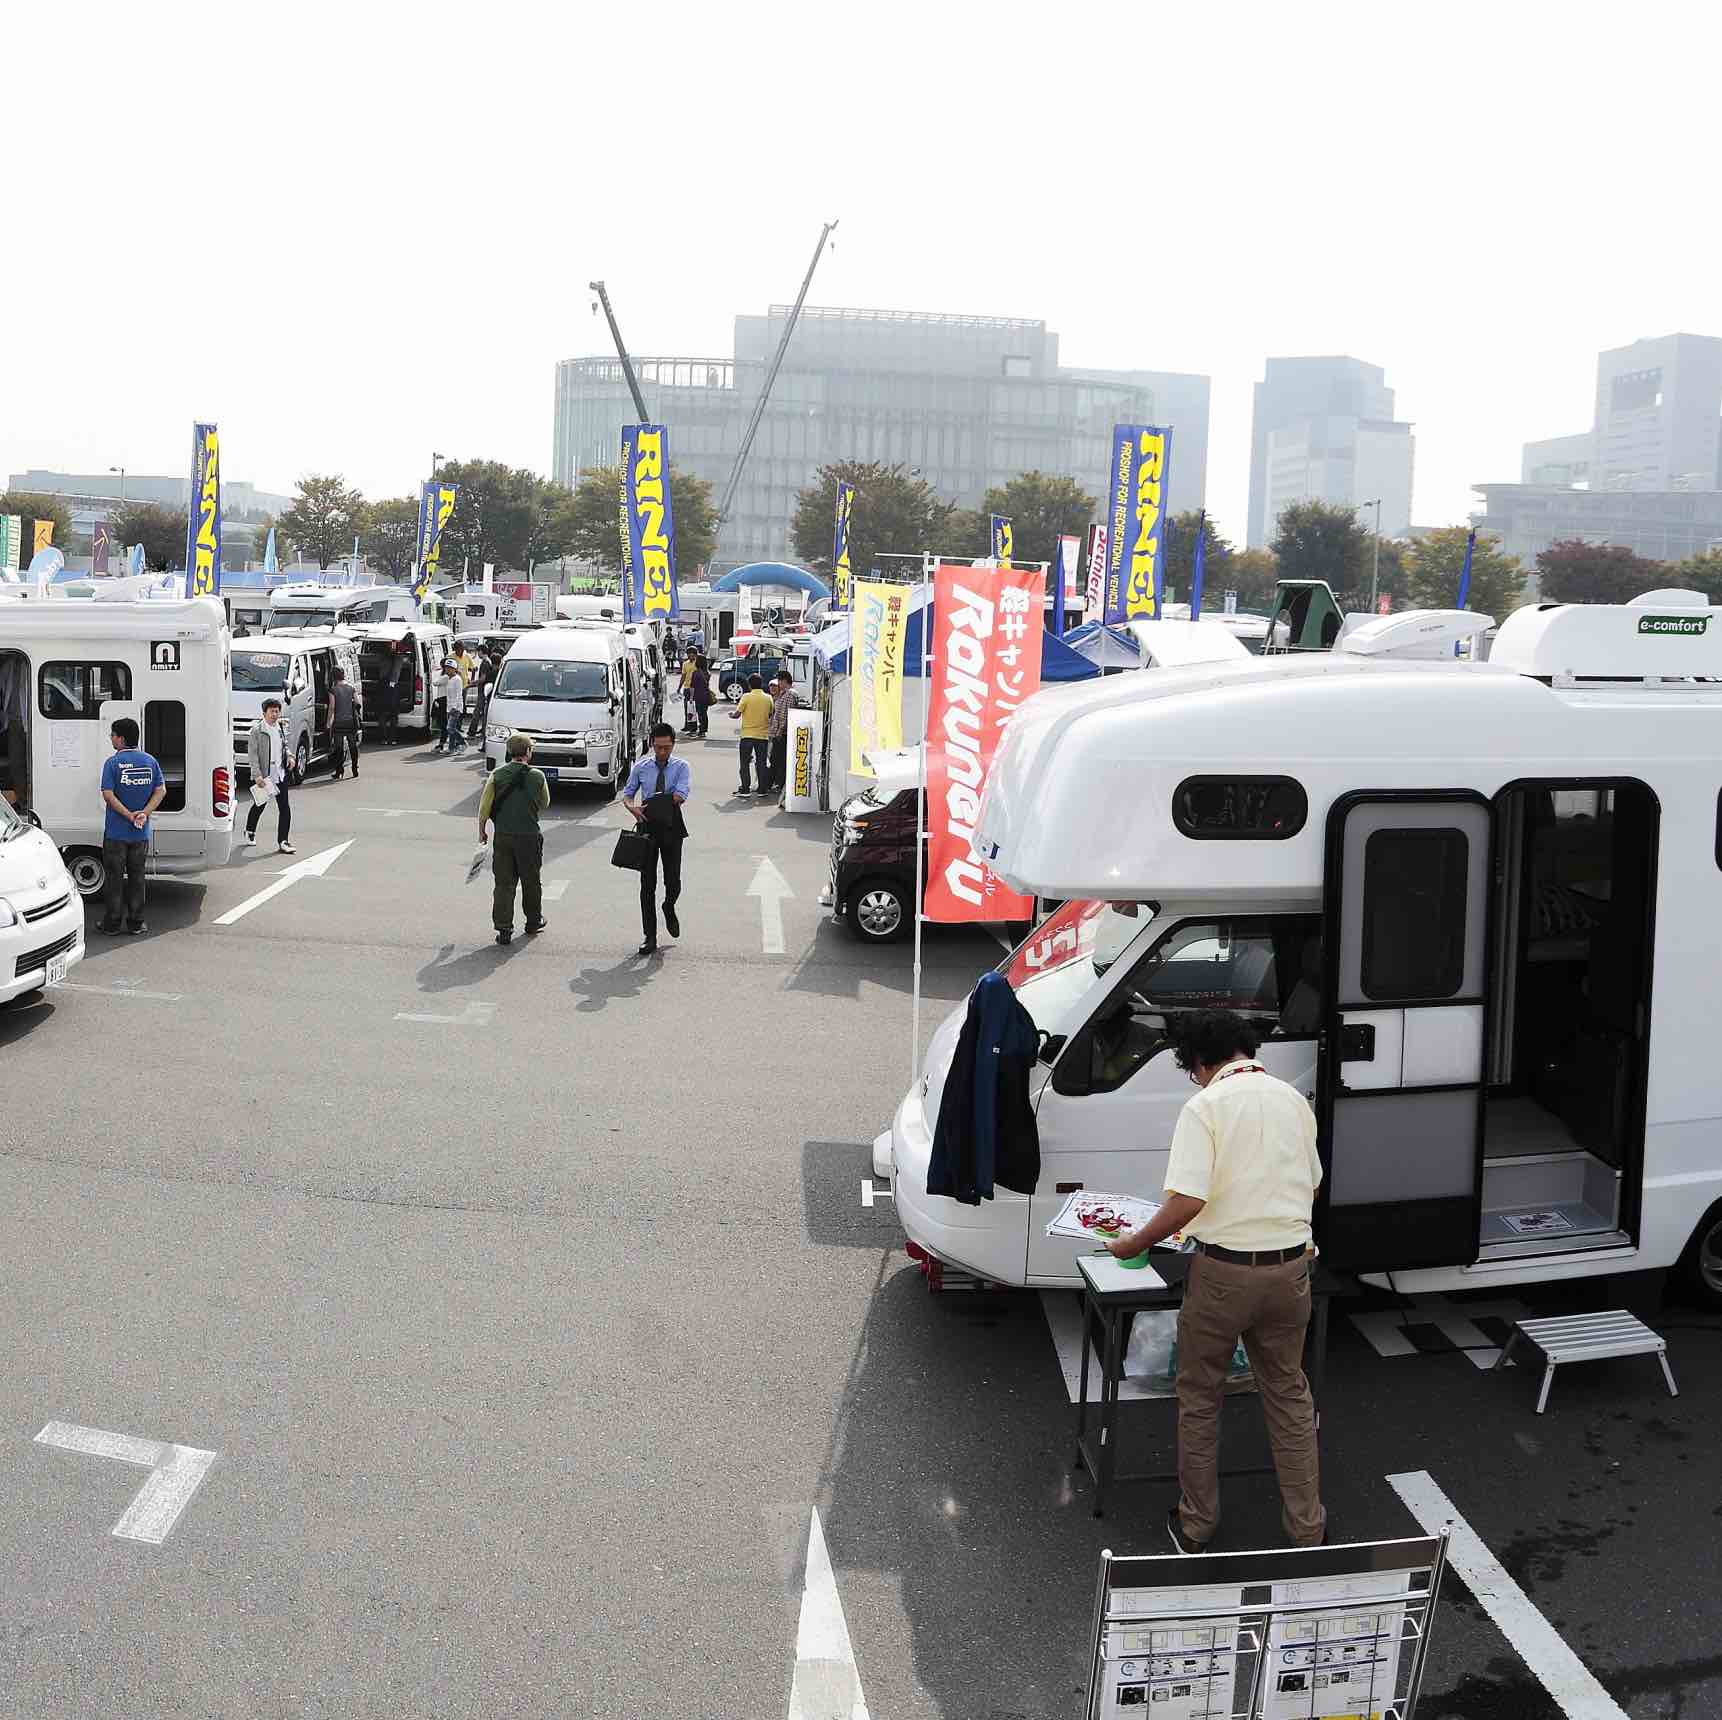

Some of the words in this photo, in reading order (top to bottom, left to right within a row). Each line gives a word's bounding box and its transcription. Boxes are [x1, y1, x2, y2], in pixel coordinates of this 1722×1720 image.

[1116, 485, 1130, 505] FOR
[1117, 441, 1133, 484] PROSHOP
[635, 430, 672, 616] RINEI
[1110, 506, 1128, 571] RECREATIONAL
[1126, 430, 1165, 617] RINEI
[1107, 574, 1121, 610] VEHICLE
[882, 595, 902, 693] 軽キャンパー
[1640, 619, 1704, 632] e-comfort
[794, 727, 809, 797] RINEI
